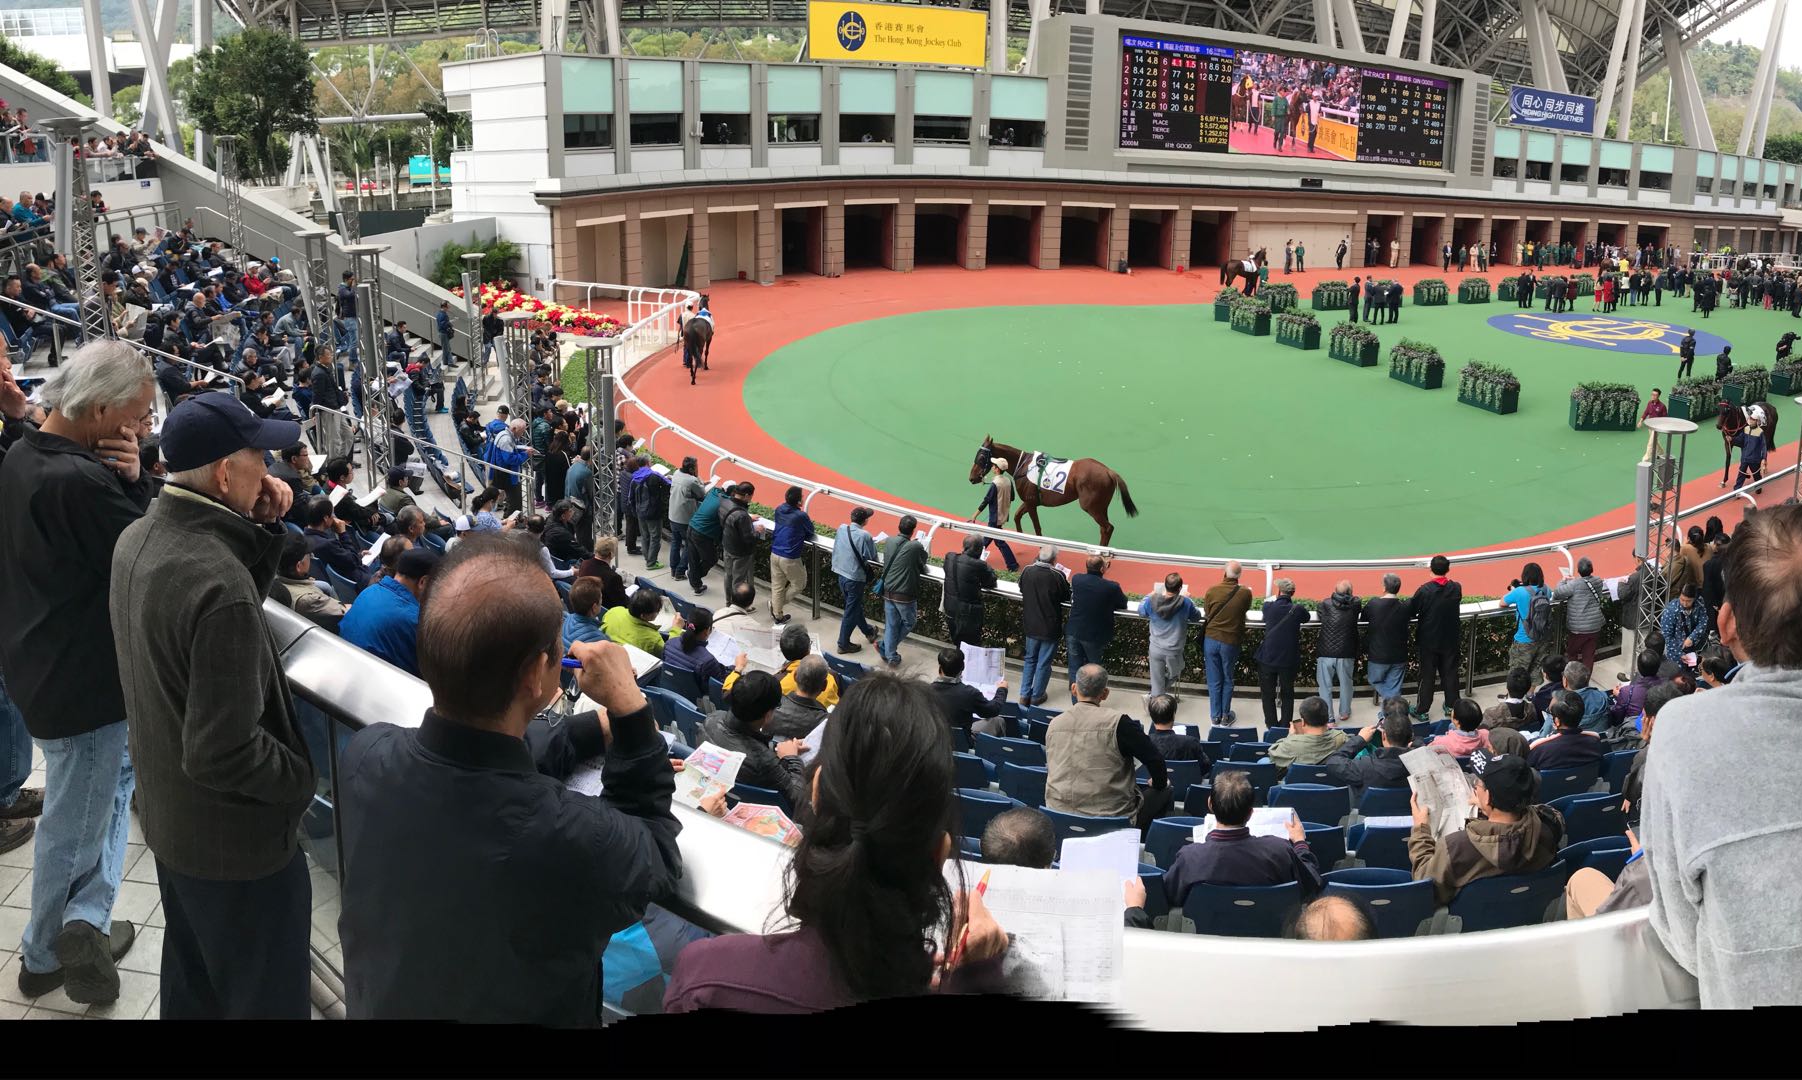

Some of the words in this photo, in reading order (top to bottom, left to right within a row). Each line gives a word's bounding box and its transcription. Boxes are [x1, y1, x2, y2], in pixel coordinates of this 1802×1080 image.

[876, 22, 924, 33] 香港賽馬會
[875, 35, 887, 43] The
[888, 36, 904, 44] Hong
[906, 37, 922, 47] Kong
[924, 38, 945, 48] Jockey
[947, 39, 962, 47] Club
[1137, 40, 1154, 48] RACE
[1172, 59, 1182, 67] 4.1
[1186, 60, 1196, 68] 1.5
[1209, 63, 1219, 71] 8.6
[1147, 68, 1158, 76] 2.8
[1208, 74, 1219, 82] 8.7
[1221, 76, 1231, 84] 2.9
[1184, 83, 1195, 91] 4.2
[1132, 90, 1143, 98] 7.8
[1145, 91, 1157, 99] 2.6
[1132, 101, 1143, 109] 7.3
[1145, 102, 1156, 110] 2.6
[1171, 104, 1180, 112] 20
[1522, 109, 1541, 117] RIDING
[1542, 111, 1556, 119] HIGH
[1556, 113, 1584, 123] TOGETHER
[1053, 471, 1067, 492] 2
